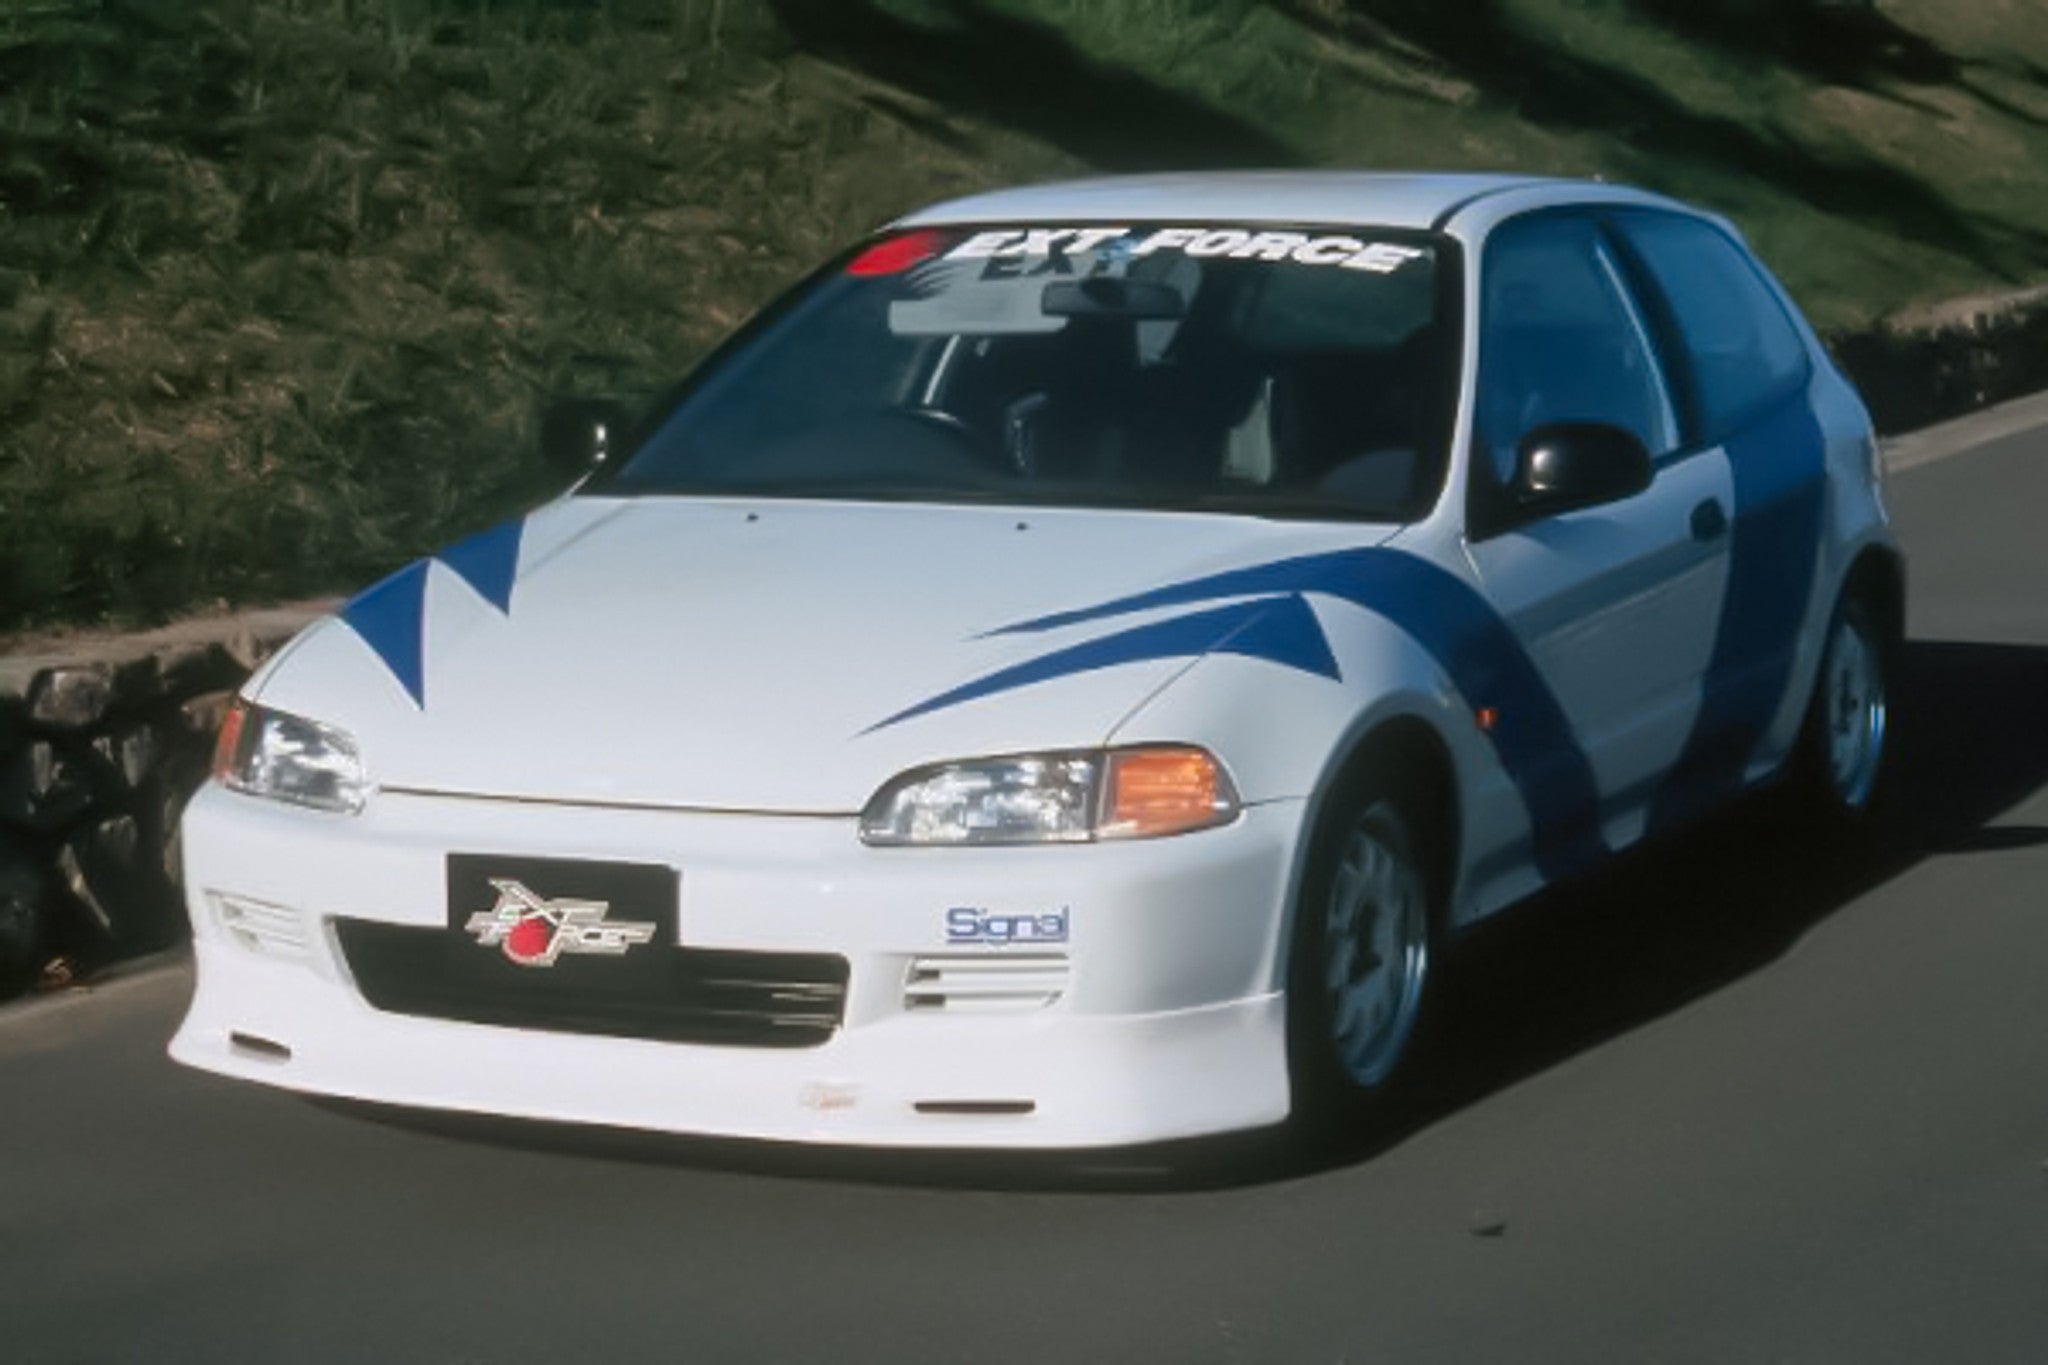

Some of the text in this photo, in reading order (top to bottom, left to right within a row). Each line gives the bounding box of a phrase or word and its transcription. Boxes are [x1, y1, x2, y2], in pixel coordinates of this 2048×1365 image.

[942, 228, 1421, 274] EXT FORCE
[946, 904, 1070, 946] Signal
